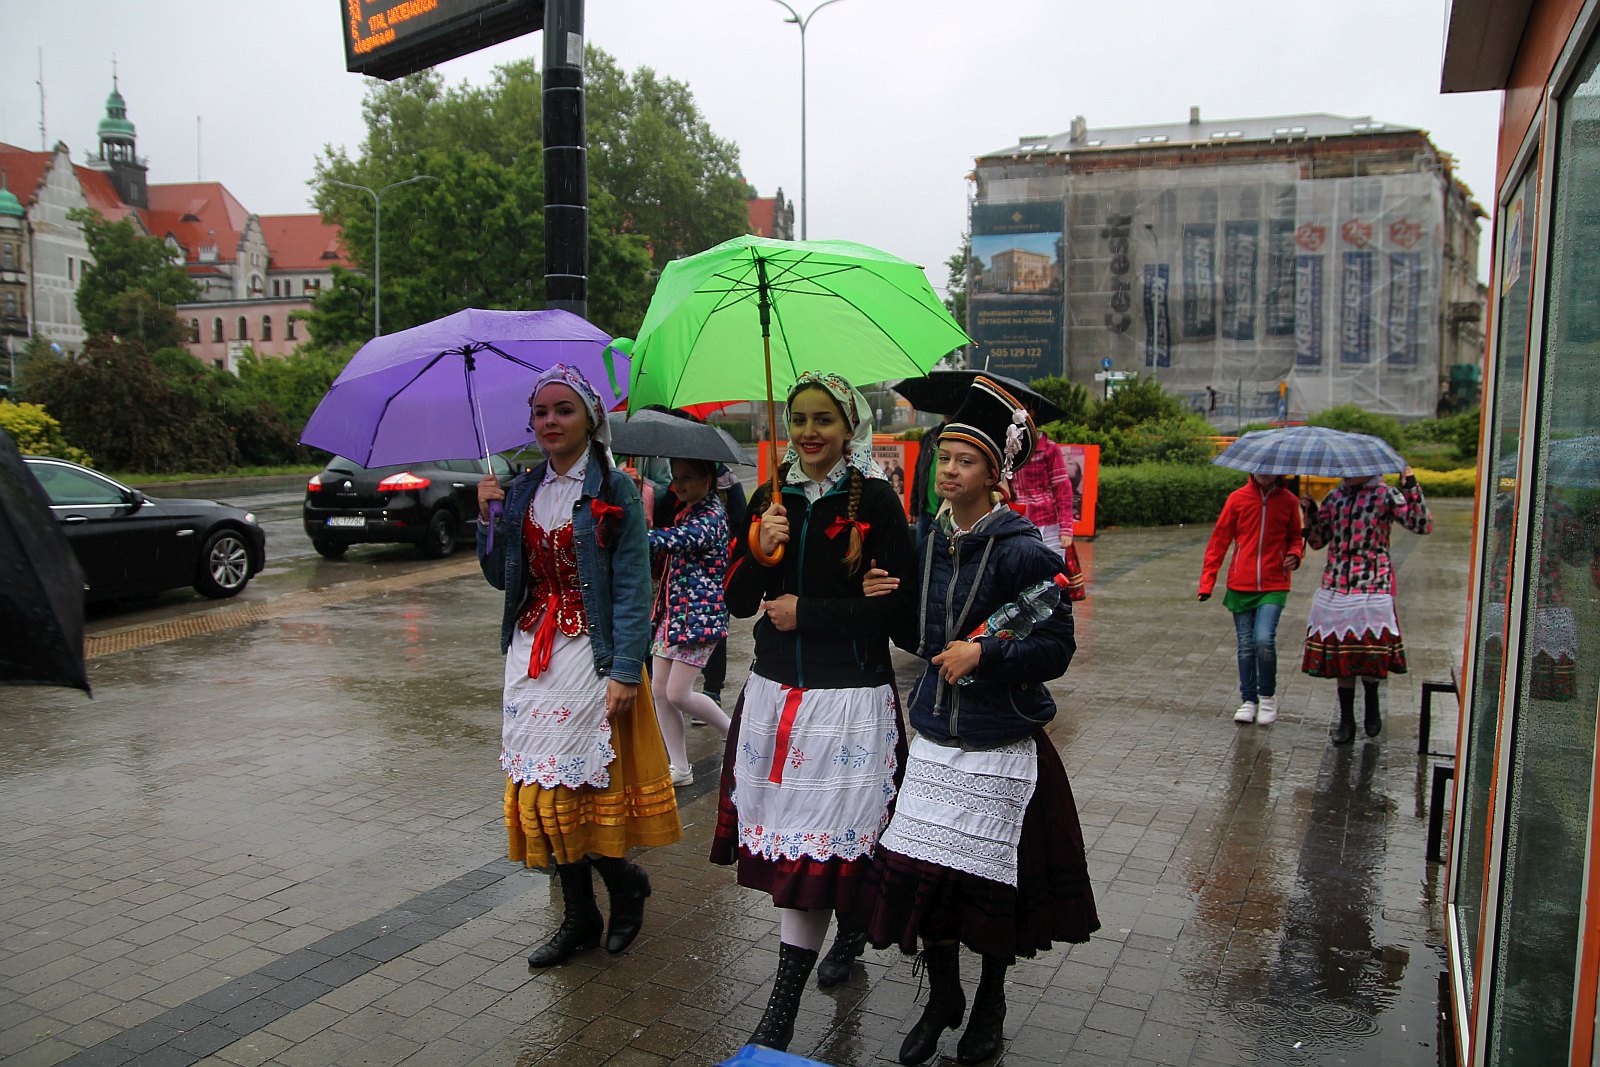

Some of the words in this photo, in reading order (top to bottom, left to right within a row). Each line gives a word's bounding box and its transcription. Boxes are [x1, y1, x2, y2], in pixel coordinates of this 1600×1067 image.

[991, 348, 1008, 357] 505
[1010, 348, 1025, 357] 129
[1027, 348, 1041, 357] 122
